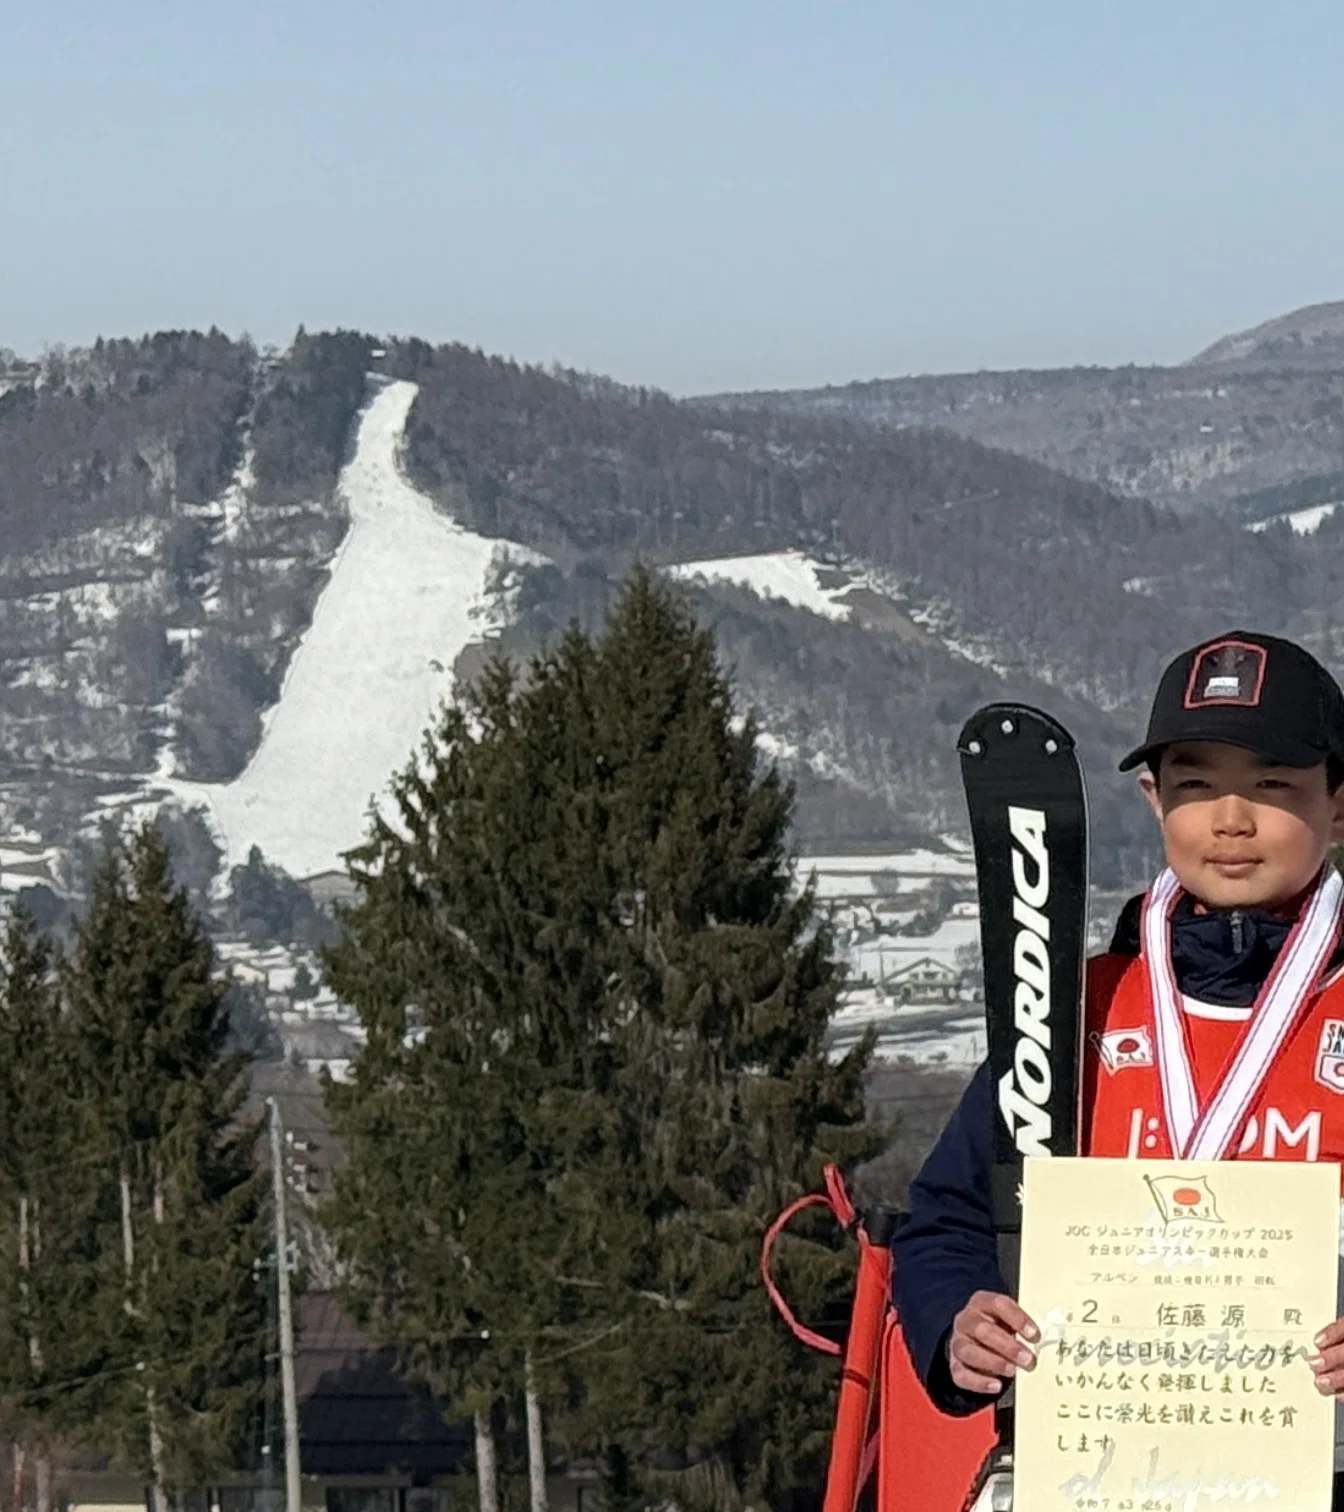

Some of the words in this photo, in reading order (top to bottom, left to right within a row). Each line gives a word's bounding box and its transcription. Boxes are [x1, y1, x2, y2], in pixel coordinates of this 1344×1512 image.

[999, 805, 1053, 1158] NORDICA
[1065, 1226, 1090, 1237] JOC
[1156, 1302, 1208, 1328] 佐藤
[1055, 1373, 1277, 1394] いかんなく発揮しました
